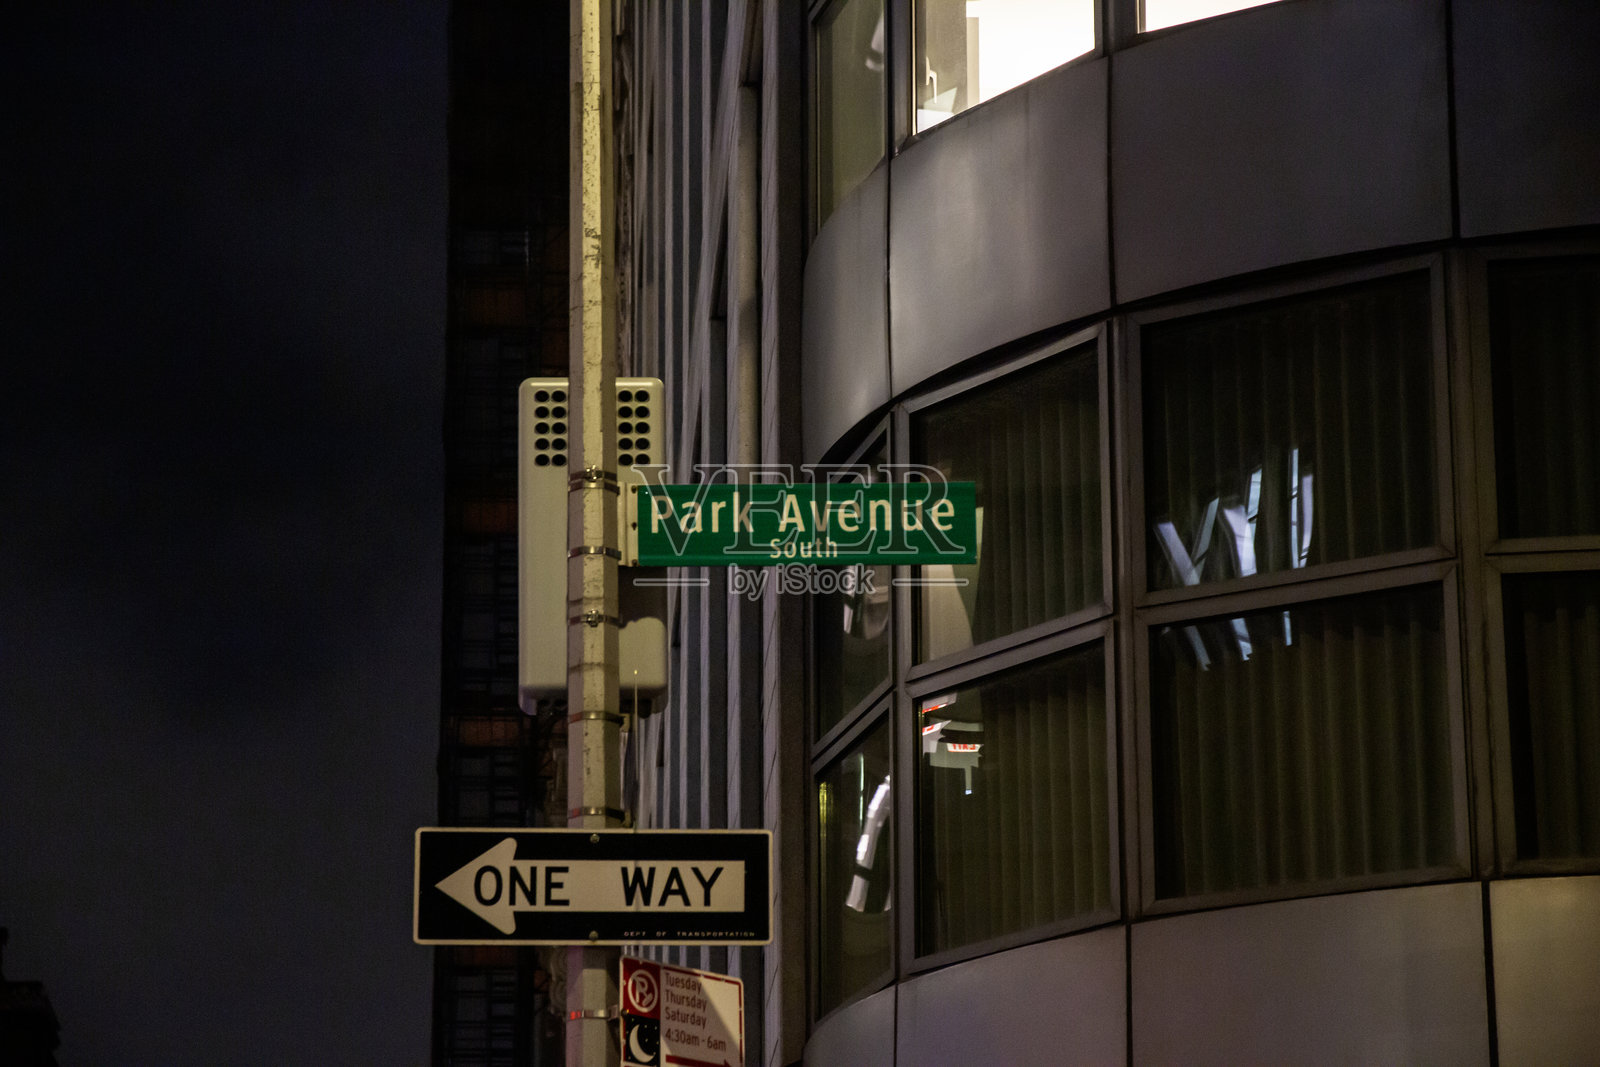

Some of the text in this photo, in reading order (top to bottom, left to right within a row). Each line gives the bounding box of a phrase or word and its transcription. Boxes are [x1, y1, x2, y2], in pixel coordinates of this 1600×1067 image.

[651, 491, 955, 534] Park Avenue
[769, 537, 838, 558] South
[474, 865, 724, 907] ONE WAY
[665, 972, 702, 993] Tuesday
[665, 989, 707, 1012] Thursday
[665, 1006, 707, 1029] Saturday
[665, 1028, 700, 1047] 4:30am
[707, 1035, 726, 1051] 6am
